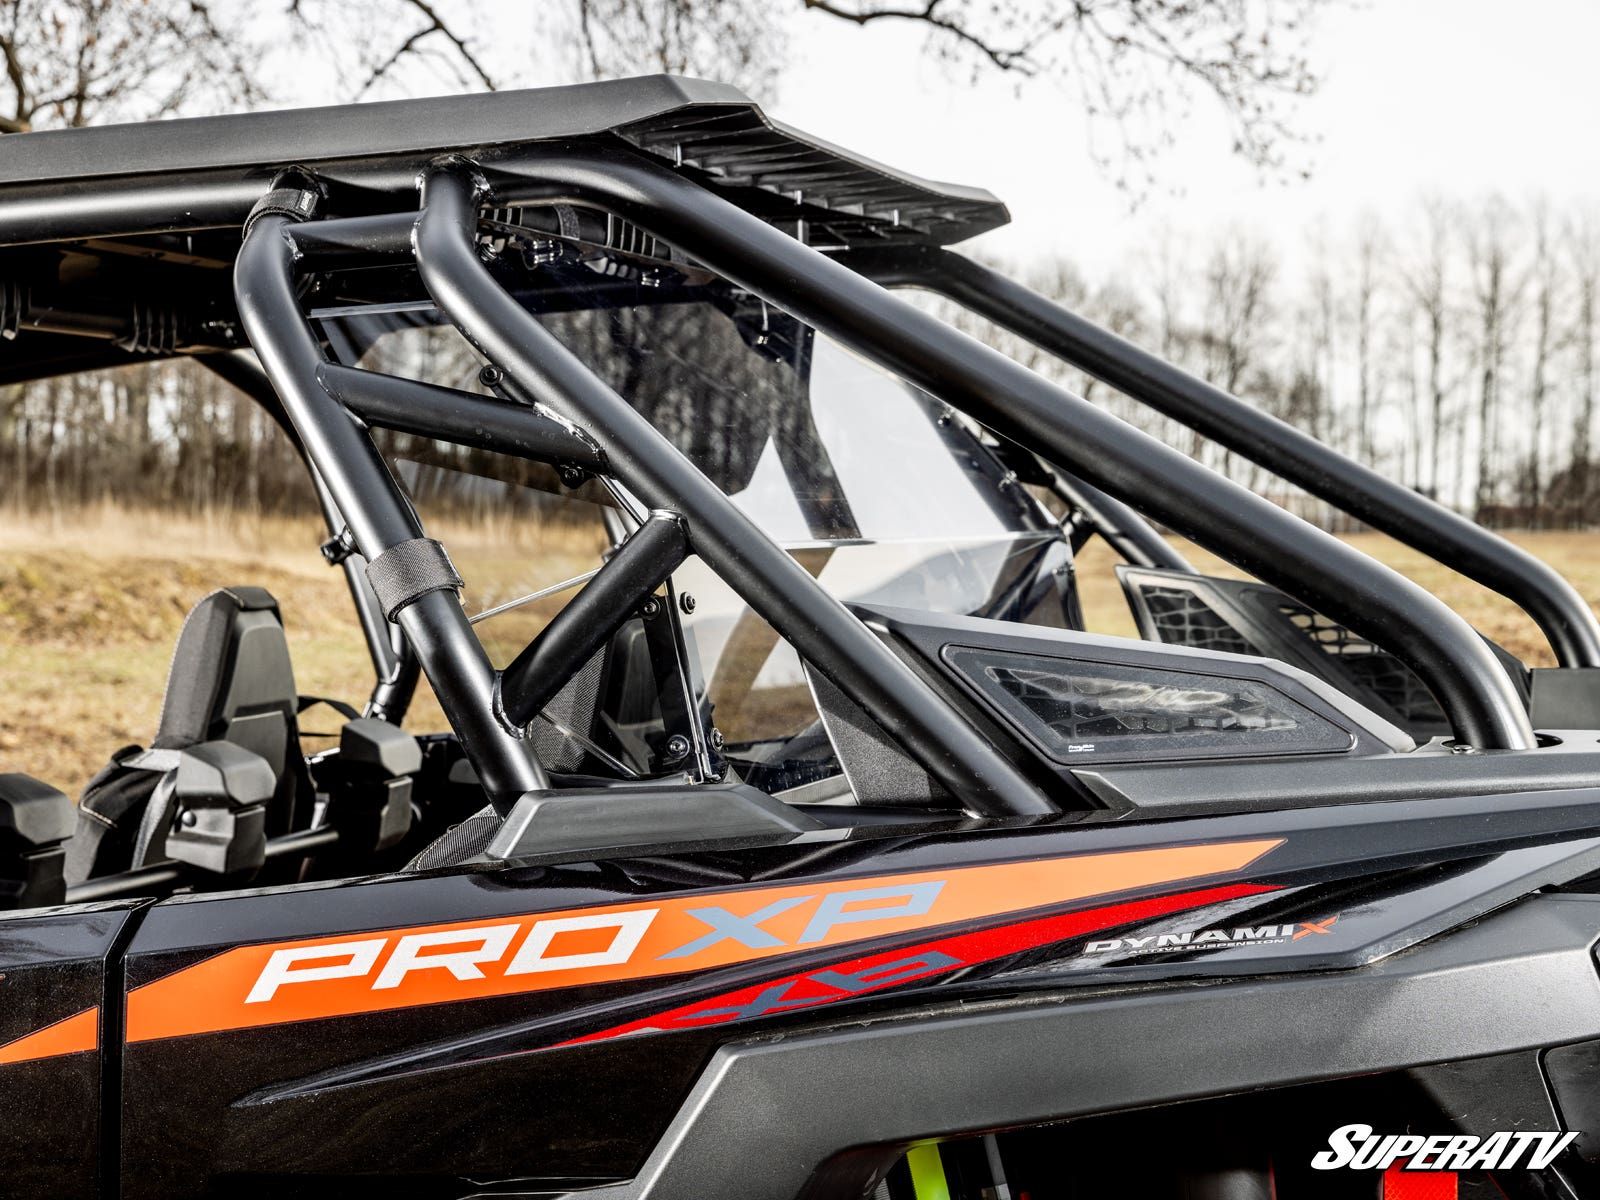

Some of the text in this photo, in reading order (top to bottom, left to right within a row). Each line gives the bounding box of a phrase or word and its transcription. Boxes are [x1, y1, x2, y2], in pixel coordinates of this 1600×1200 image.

[245, 880, 947, 1003] PRO XP
[1084, 916, 1338, 954] DYNAMIX
[1186, 938, 1284, 950] SUSPENSION
